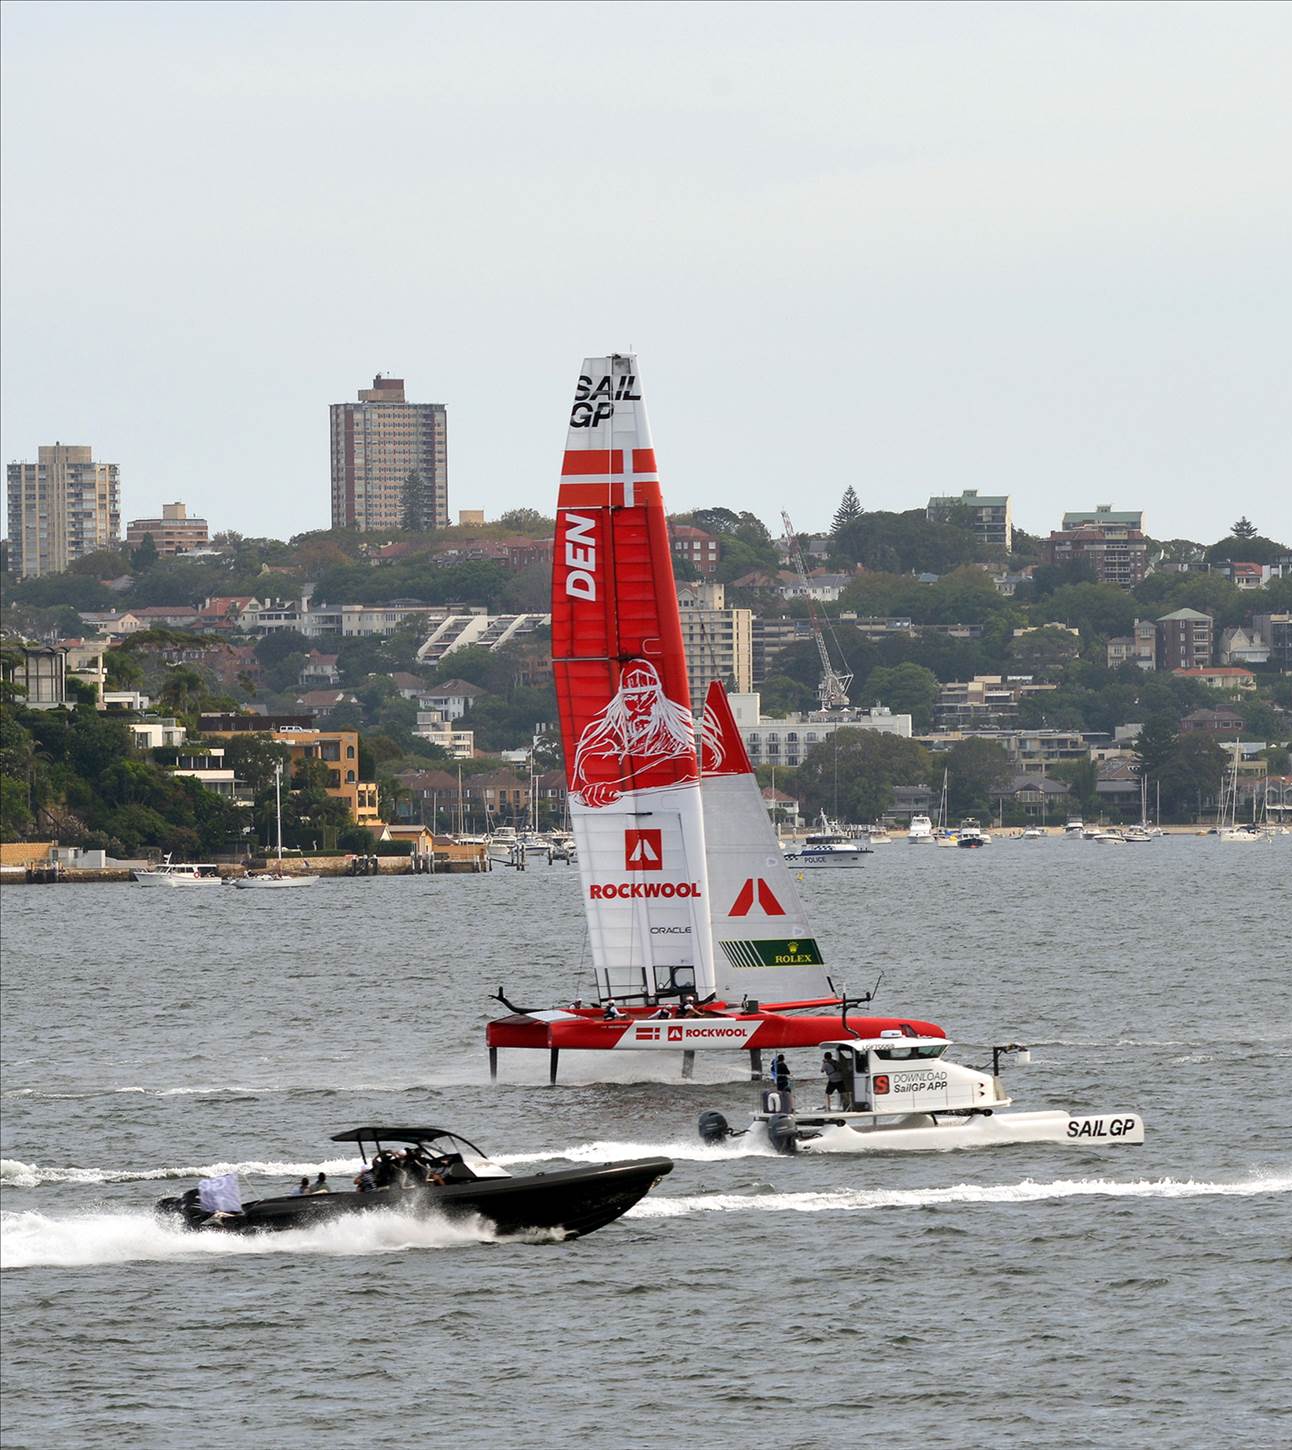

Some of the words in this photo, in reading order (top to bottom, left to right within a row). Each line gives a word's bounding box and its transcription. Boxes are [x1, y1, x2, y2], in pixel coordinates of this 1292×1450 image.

[575, 375, 641, 401] SAIL
[570, 402, 614, 428] GP
[565, 513, 597, 602] DEN
[804, 856, 827, 864] POLICE
[590, 882, 702, 900] ROCKWOOL
[650, 926, 693, 935] ORACLE
[775, 954, 812, 964] ROLEX
[686, 1028, 748, 1038] ROCKWOOL
[893, 1071, 948, 1084] DOWNLOAD
[927, 1081, 948, 1091] APP
